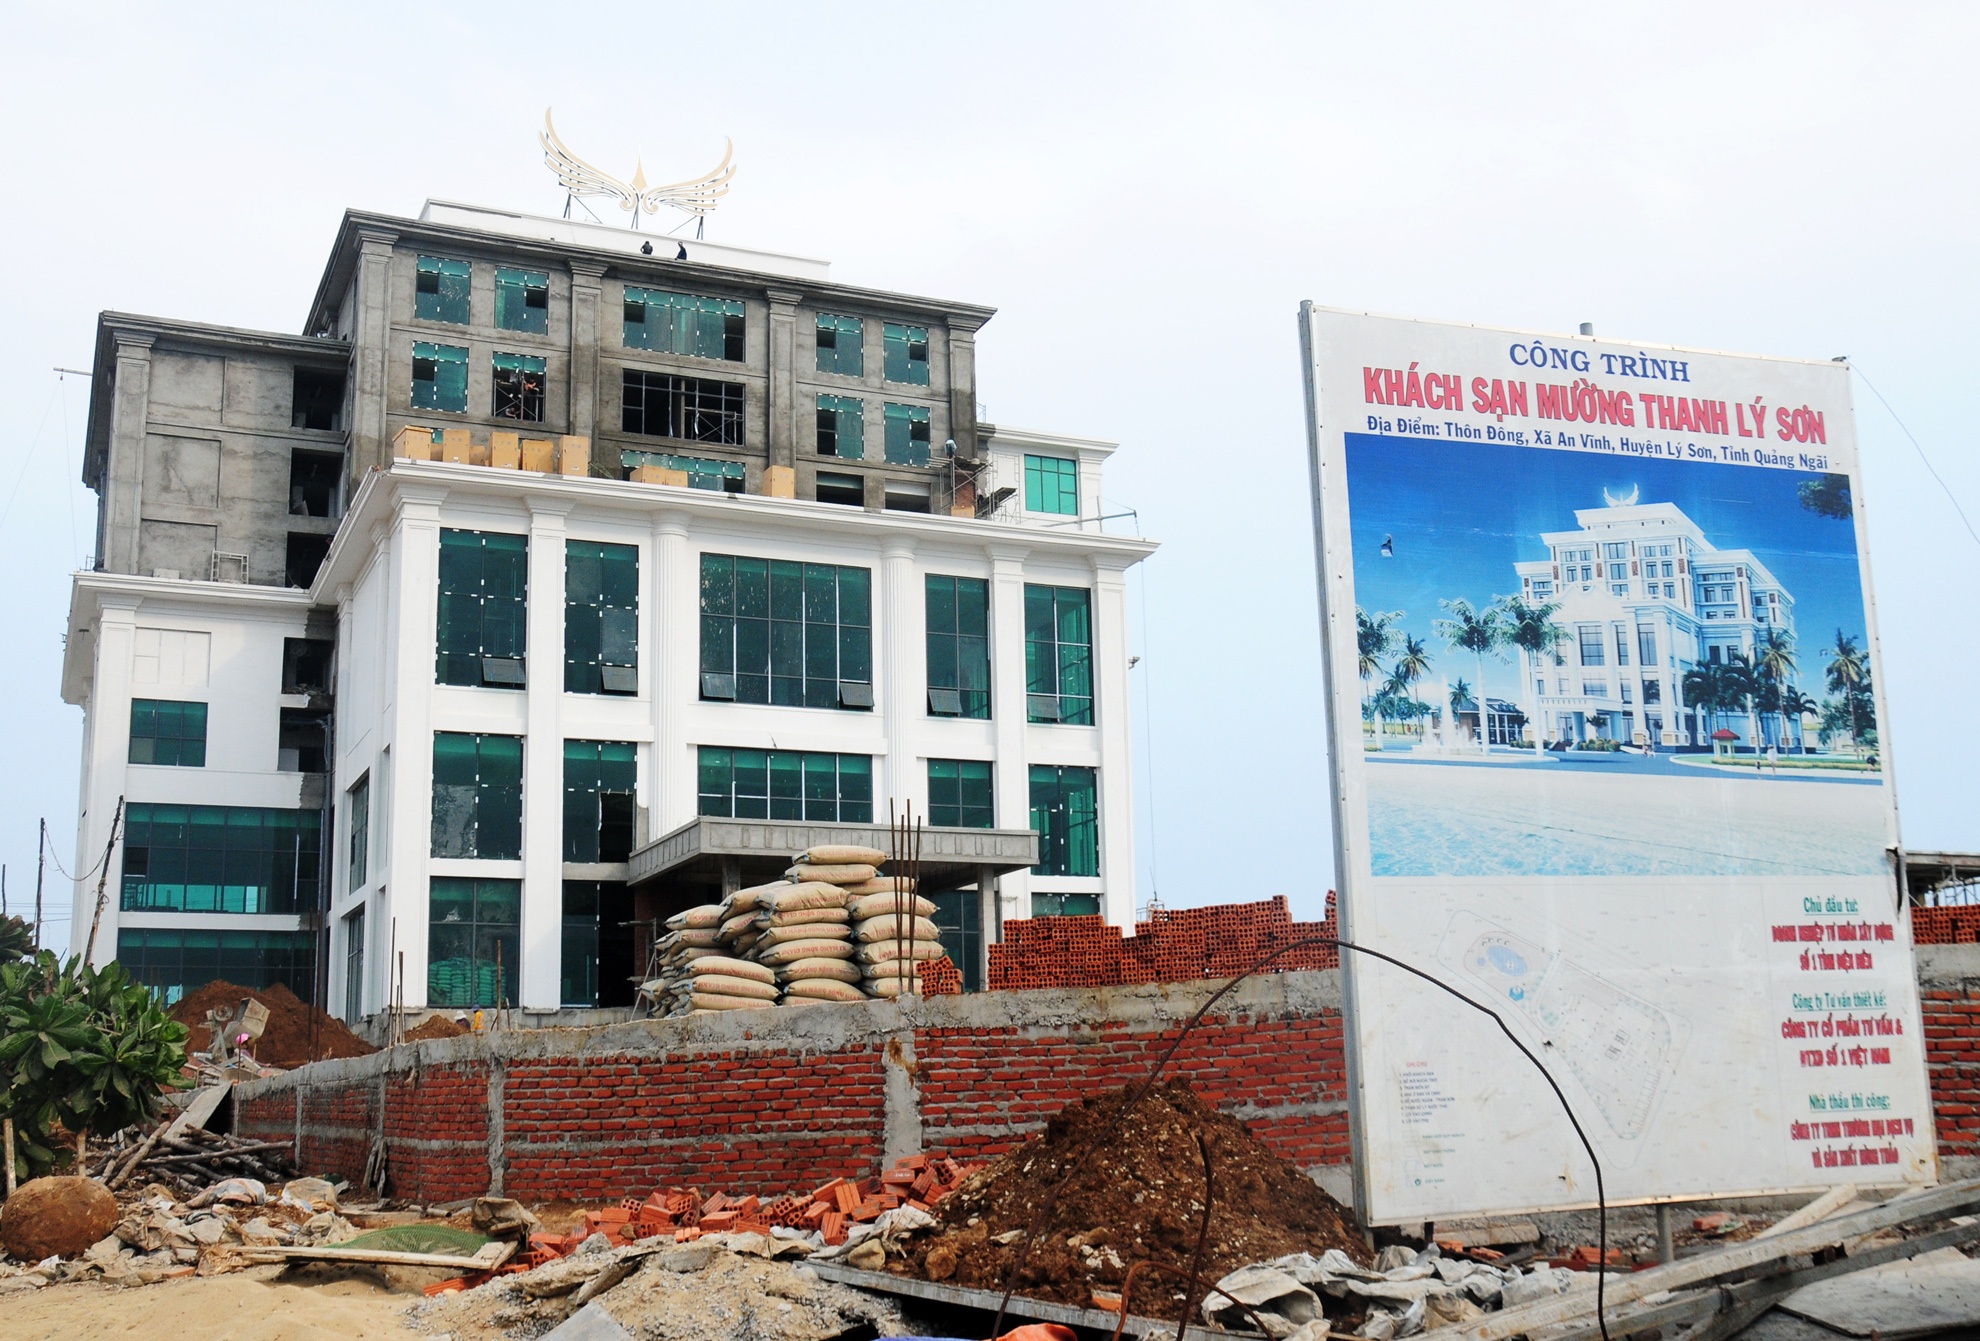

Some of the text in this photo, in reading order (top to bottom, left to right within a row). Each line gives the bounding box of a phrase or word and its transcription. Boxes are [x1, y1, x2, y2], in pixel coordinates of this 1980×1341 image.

[1510, 340, 1690, 382] CÔNG TRÌNH
[1363, 362, 1826, 444] KHÁCH SẠN MƯỜNG THANH LÝ SƠN
[1368, 416, 1827, 470] Địa Điểm: Thôn Đông, Xã An Vĩnh, Huyện Lý Sơn, Tỉnh Quảng Ngãi
[1804, 896, 1822, 912] Chủ
[1826, 895, 1843, 912] đầu
[1793, 989, 1887, 1010] Công ty Tư vấn thiết kế:
[1782, 1012, 1903, 1039] CÔNG TY CỔ PHẦN TƯ VẤN &
[1809, 1091, 1890, 1109] Nhà thầu thi công:
